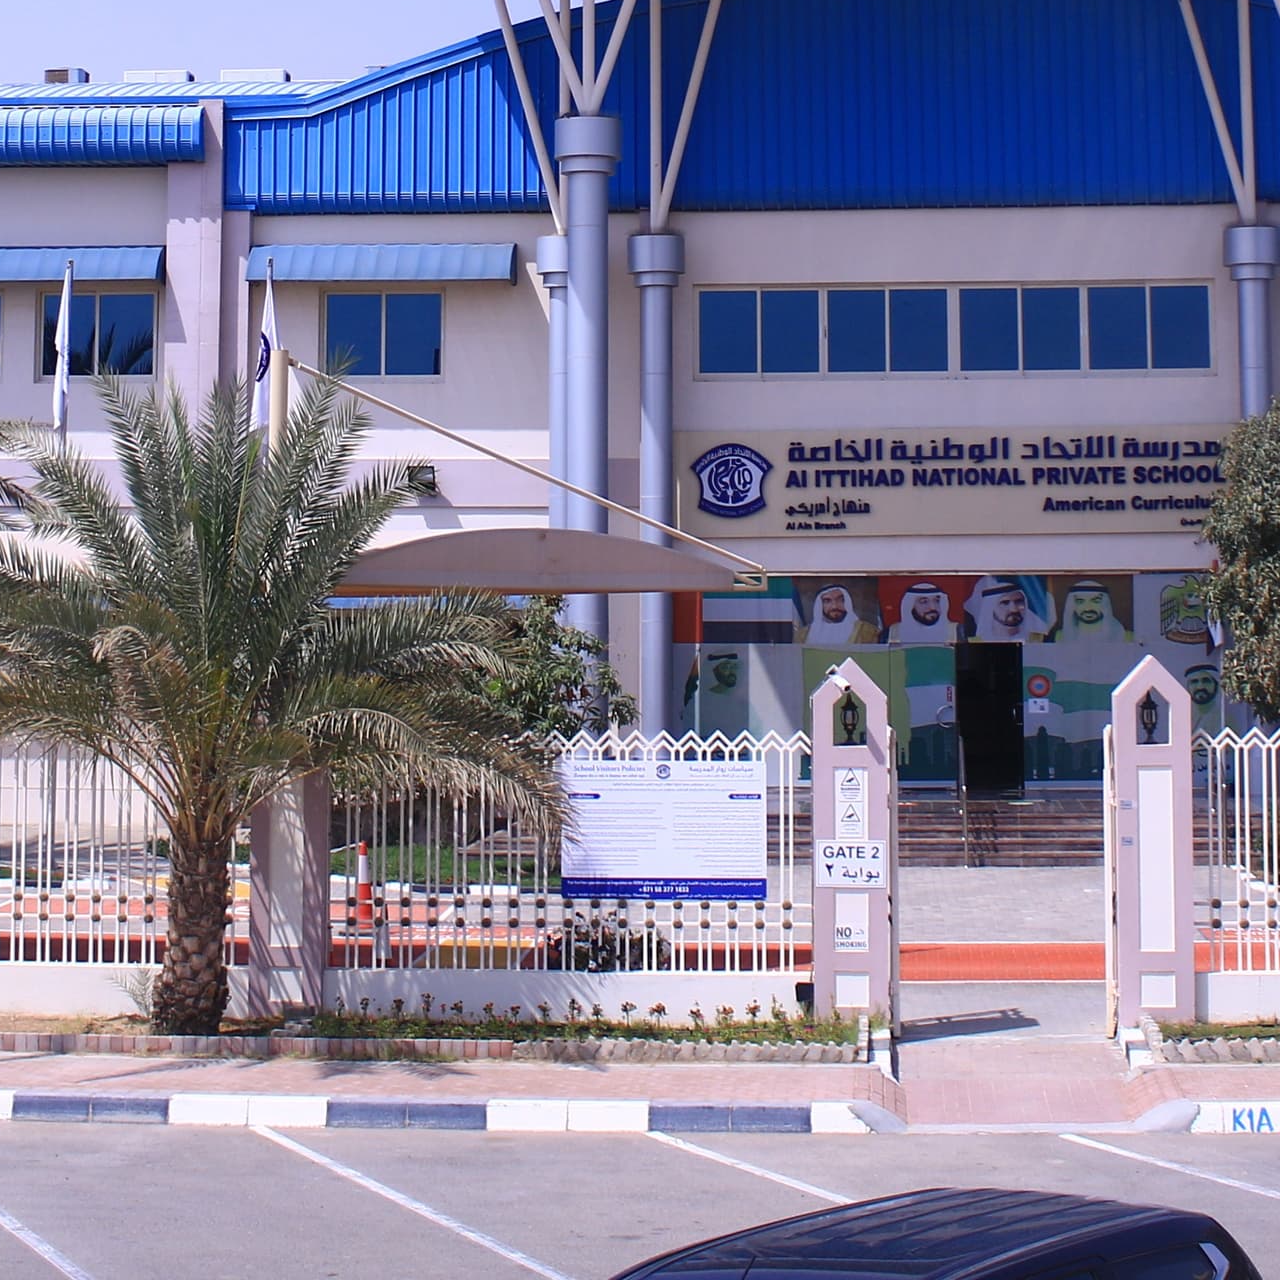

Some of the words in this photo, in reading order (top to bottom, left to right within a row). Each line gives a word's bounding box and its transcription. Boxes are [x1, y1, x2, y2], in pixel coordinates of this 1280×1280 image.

[787, 438, 883, 463] الخاصة
[890, 437, 1010, 464] الوطنية
[1021, 435, 1115, 461] الاتحاد
[1122, 437, 1221, 461] مدرسة
[815, 469, 905, 487] ITTIHAD
[912, 467, 1026, 487] NATIONAL
[1032, 466, 1127, 486] PRIVATE
[1133, 464, 1227, 484] SCHOOL
[1042, 496, 1126, 512] American
[814, 521, 847, 530] Branch
[574, 764, 596, 772] School
[596, 764, 620, 772] Visitors
[622, 764, 646, 772] Policies
[823, 845, 866, 859] GATE
[871, 846, 881, 859] 2
[841, 865, 880, 883] بوابة
[836, 927, 852, 938] NO
[1232, 1107, 1273, 1134] K1A
